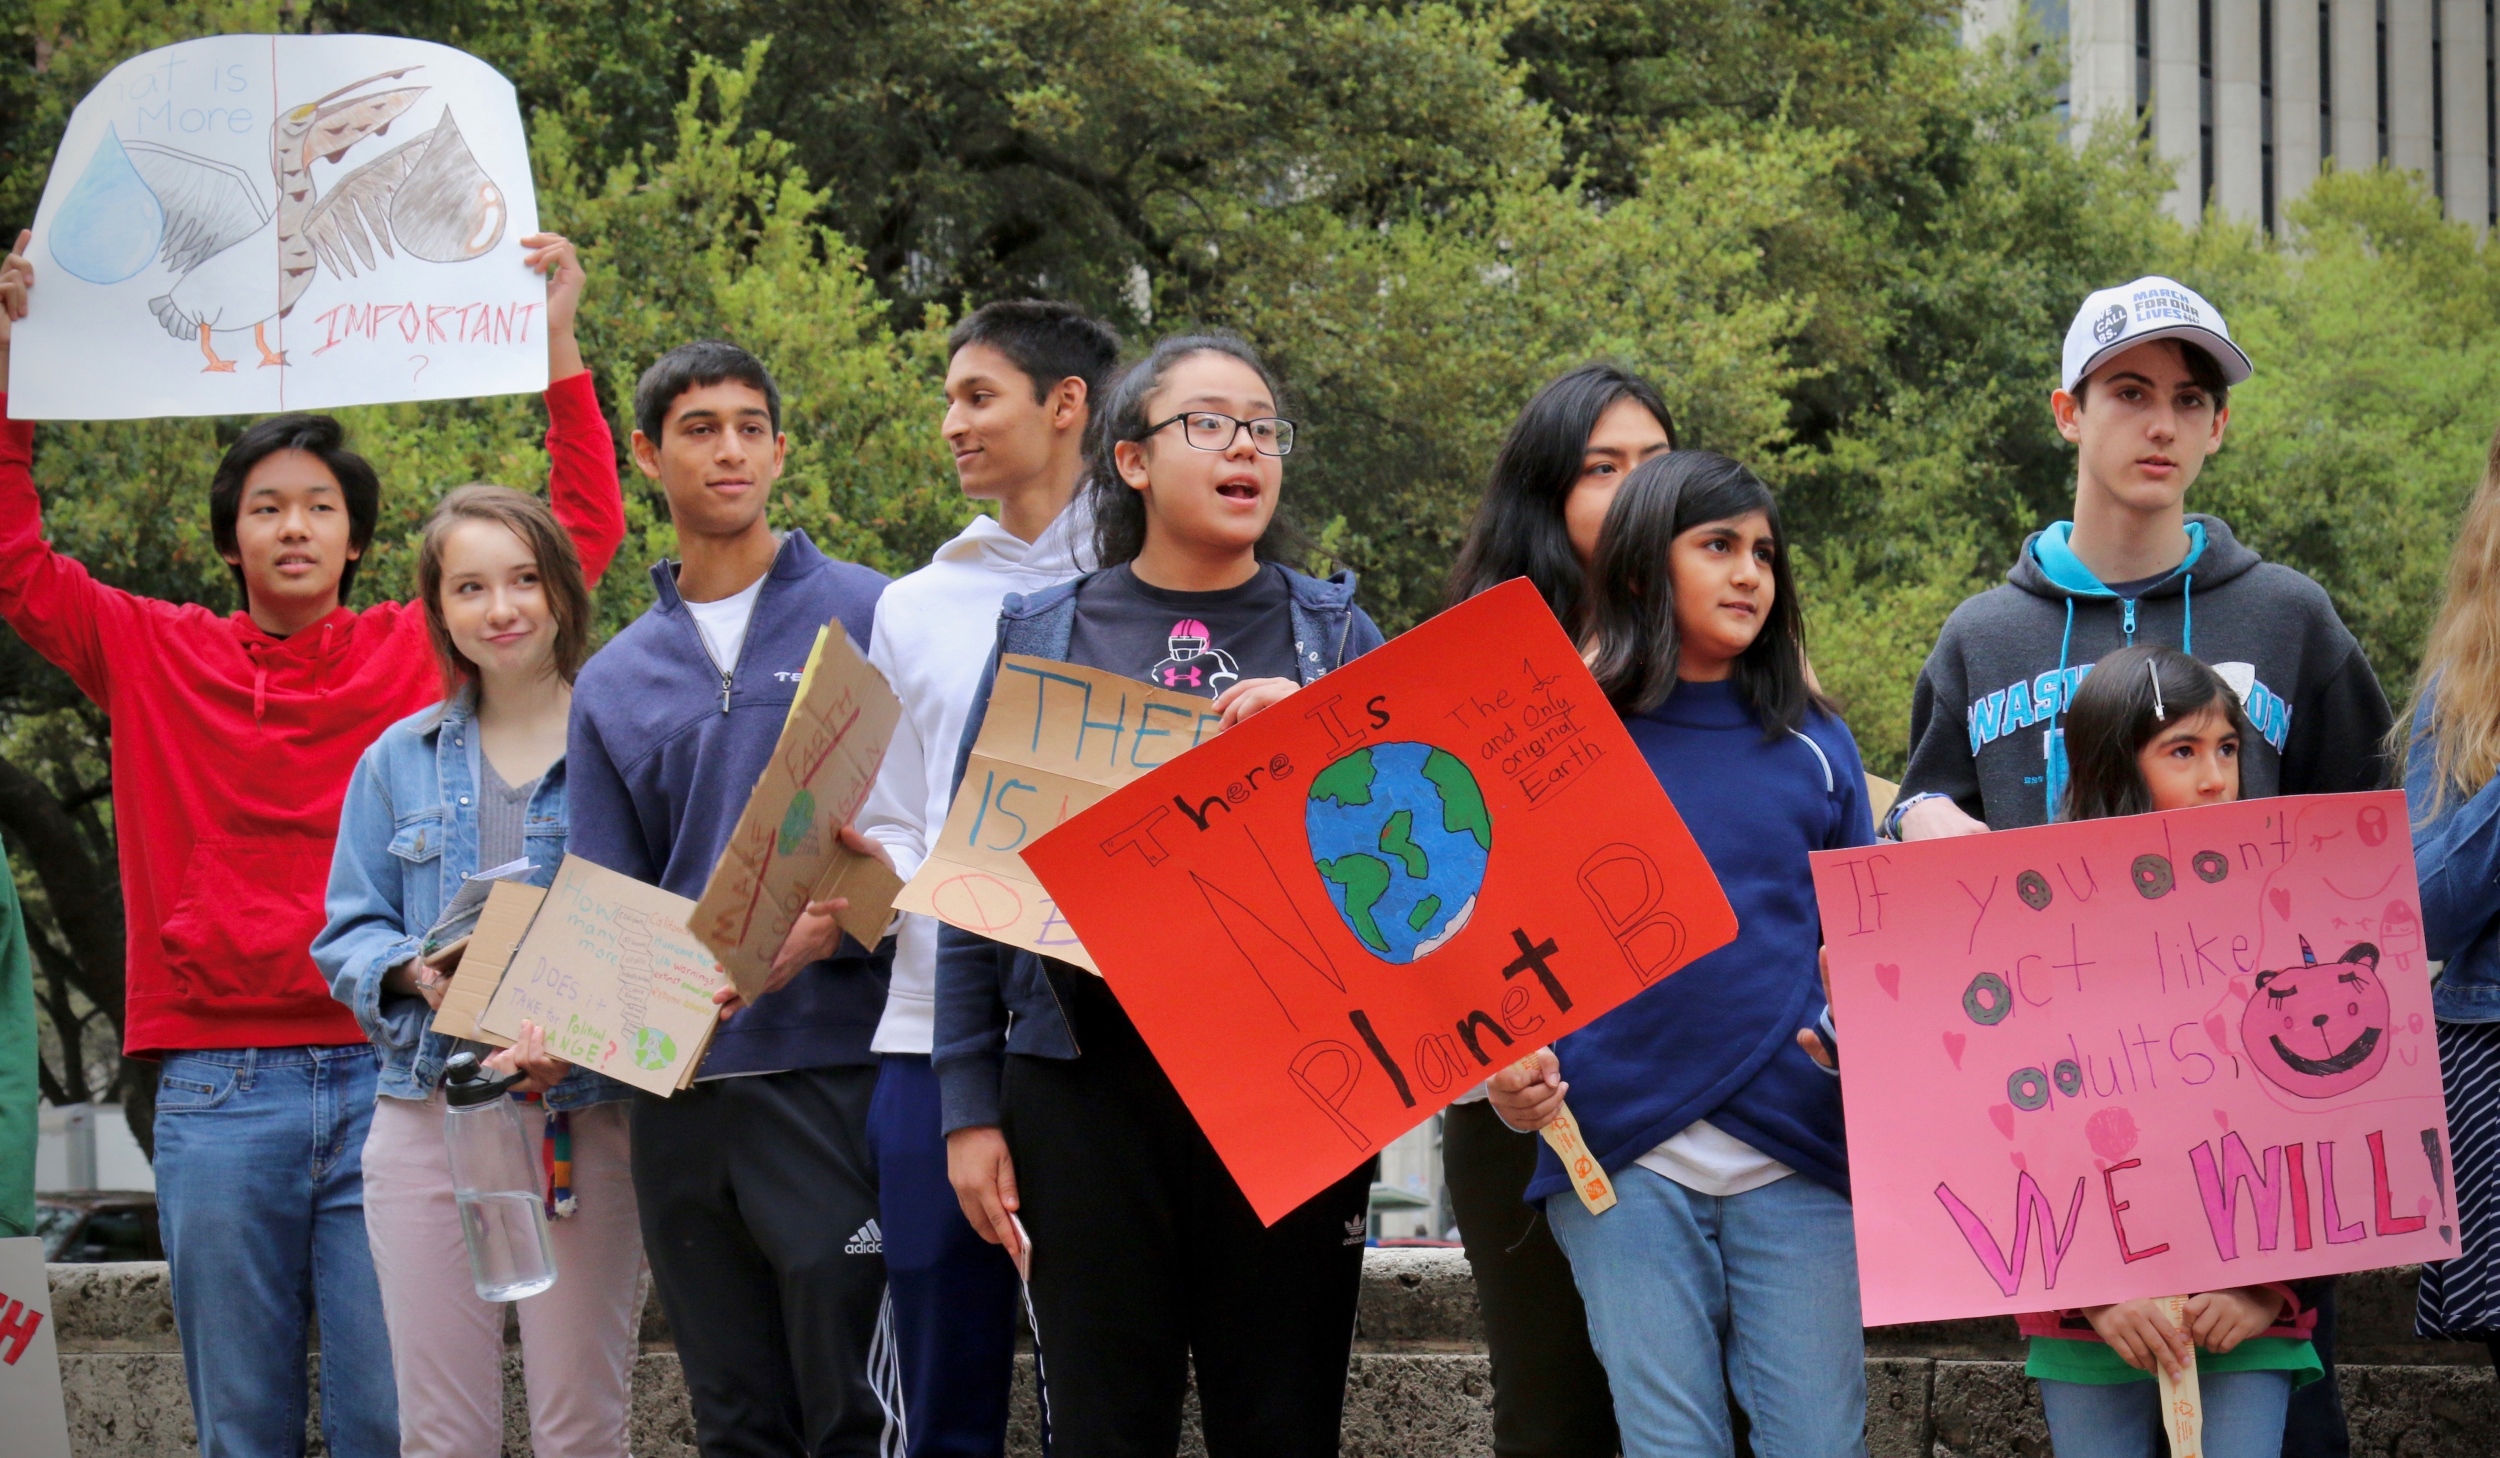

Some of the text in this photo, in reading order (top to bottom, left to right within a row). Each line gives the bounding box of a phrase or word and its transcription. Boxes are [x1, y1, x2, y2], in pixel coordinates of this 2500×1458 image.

[213, 58, 247, 92] is
[138, 100, 254, 134] More
[2096, 310, 2127, 333] CALL
[2133, 289, 2190, 304] MARCH
[2135, 298, 2199, 318] FOR OUR
[2136, 308, 2182, 322] LIVES
[311, 301, 544, 357] IMPORTANT
[2098, 329, 2118, 343] BS.
[408, 354, 428, 393] ?
[1444, 690, 1515, 729] The
[1482, 688, 1571, 760] and Only
[1502, 711, 1578, 775] original
[1100, 694, 1390, 867] There Is
[1520, 738, 1602, 803] Earth
[712, 685, 853, 946] MAKE EARTH
[968, 770, 1038, 851] IS
[561, 868, 618, 922] How
[1832, 811, 2291, 954] If you don't
[567, 913, 617, 948] many
[1577, 843, 1686, 986] B
[579, 939, 618, 965] more
[653, 971, 681, 984] extinct
[673, 963, 715, 986] warnings
[1963, 922, 2256, 1026] act like
[531, 957, 607, 1008] DOES it
[510, 987, 542, 1015] TAKE
[546, 1007, 560, 1024] for
[567, 1014, 607, 1042] Political
[1288, 927, 1574, 1152] Planet
[1934, 1128, 2453, 1297] WE WILL!
[0, 1292, 44, 1365] H
